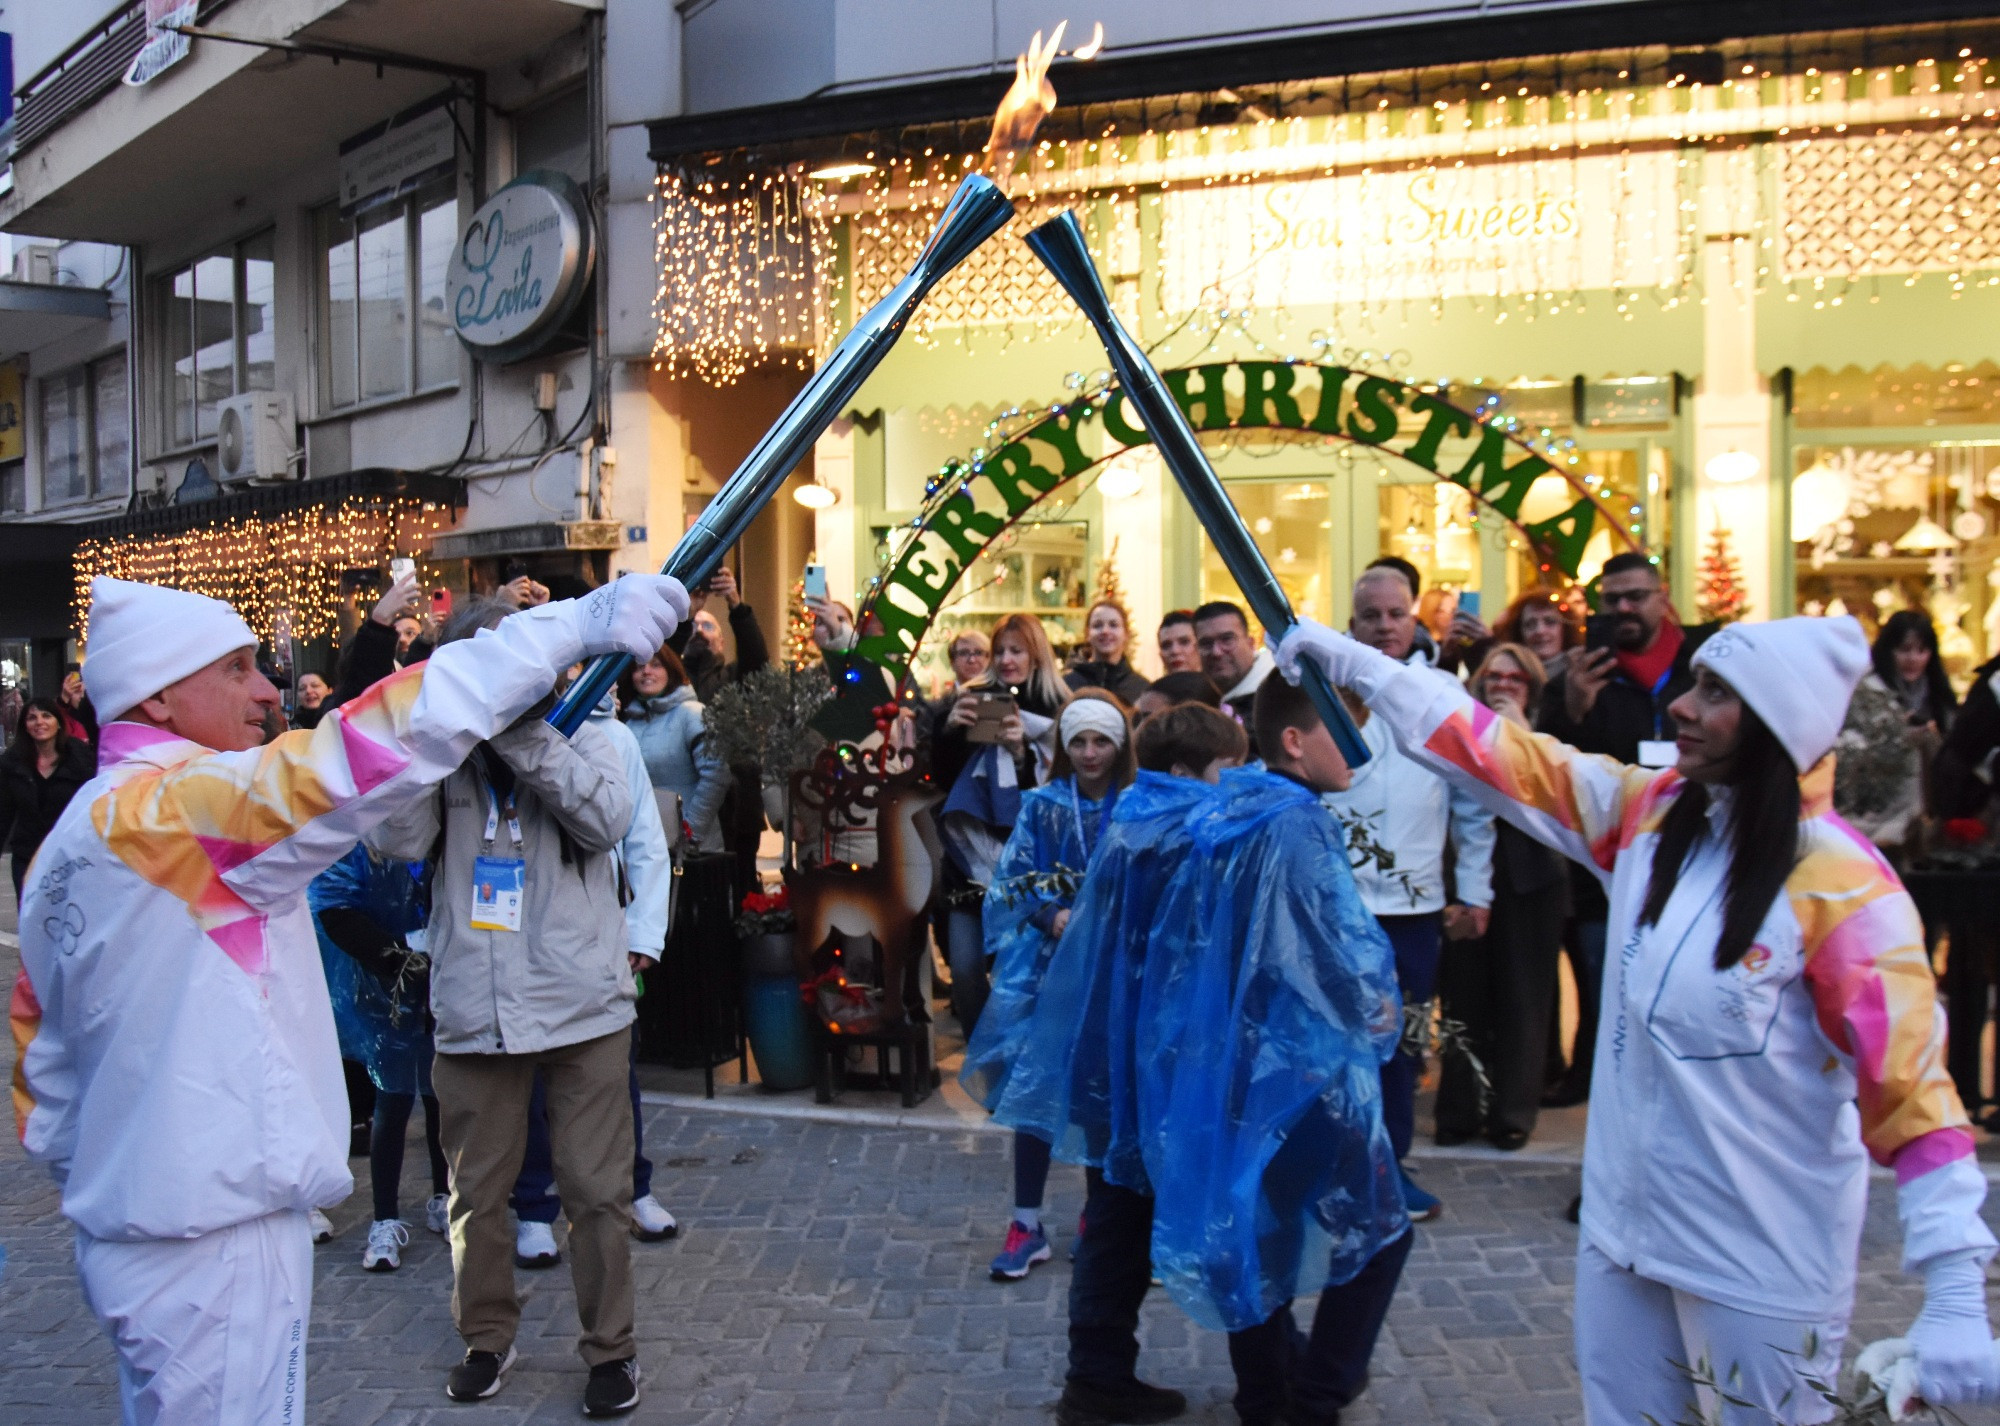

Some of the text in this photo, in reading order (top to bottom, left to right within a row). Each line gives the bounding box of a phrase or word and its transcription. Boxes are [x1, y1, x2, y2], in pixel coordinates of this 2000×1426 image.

[852, 360, 1605, 692] MERRY CHRISTMA
[291, 1318, 302, 1342] 2026
[286, 1345, 299, 1394] CORTINA
